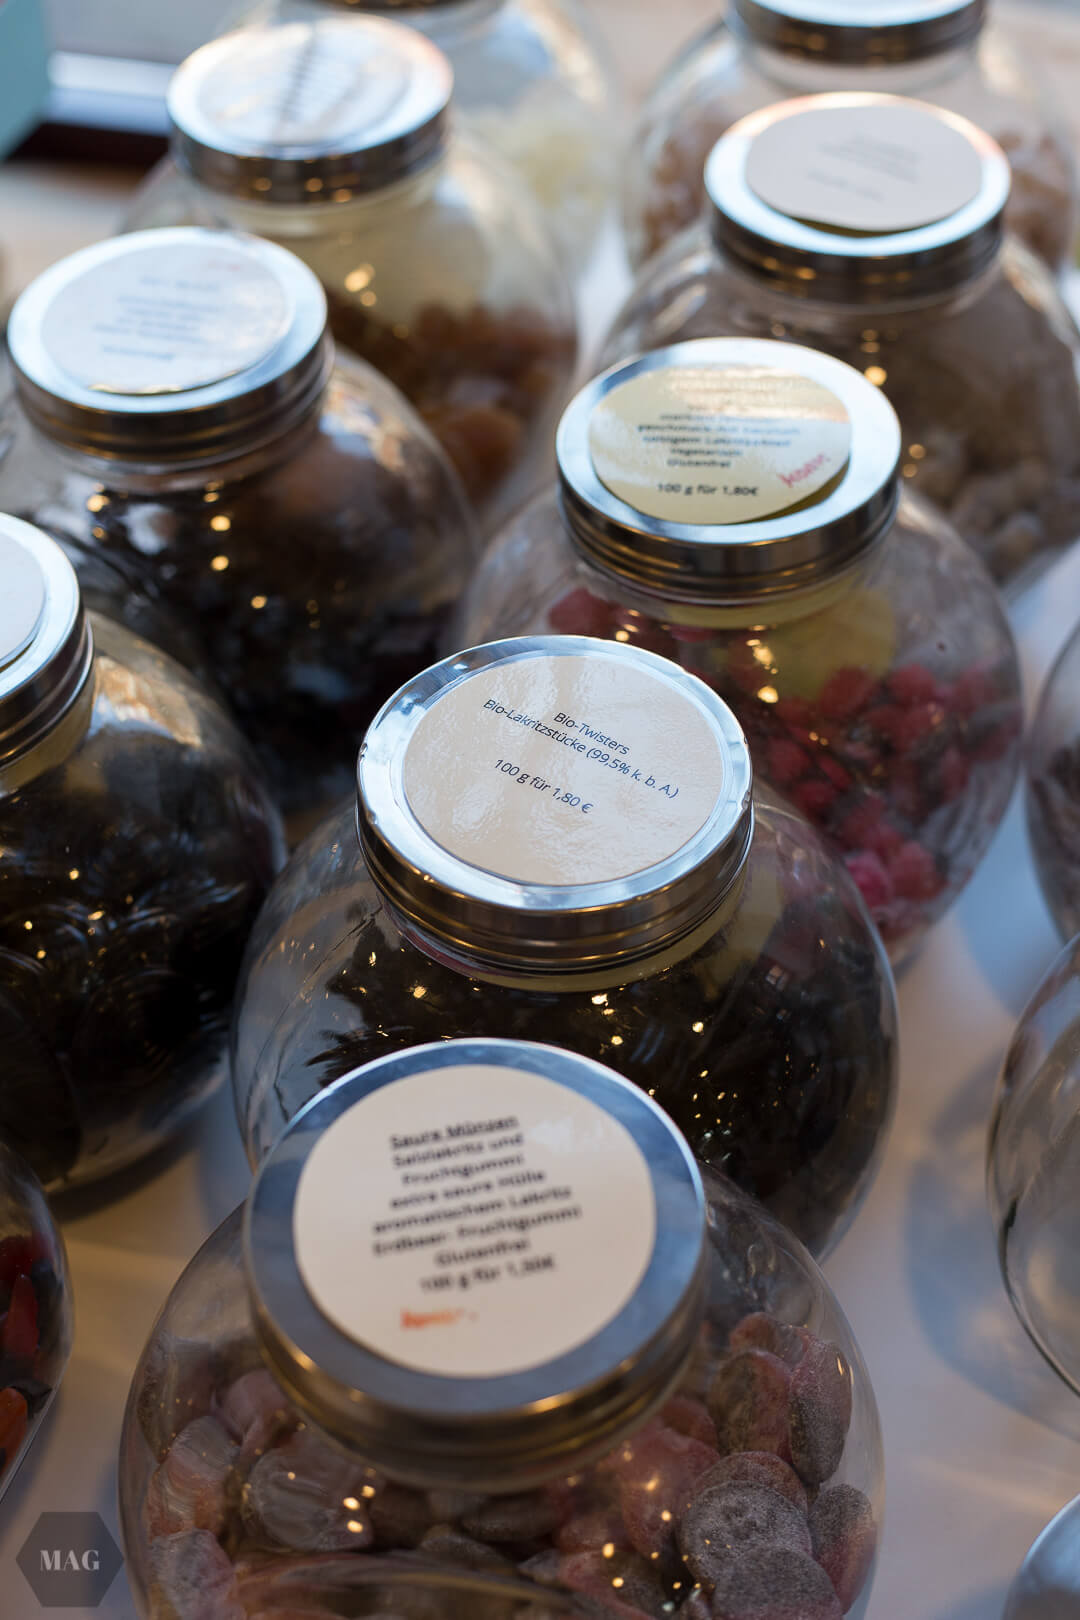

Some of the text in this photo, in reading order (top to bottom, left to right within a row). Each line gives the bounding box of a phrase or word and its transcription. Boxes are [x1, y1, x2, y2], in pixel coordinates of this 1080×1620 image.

[657, 483, 681, 493] 100
[684, 486, 693, 495] g
[697, 483, 717, 494] für
[483, 699, 680, 799] Bio-Lakritzstücke (99,5% k. b. A.)
[553, 712, 630, 755] Bio-Twisters
[494, 758, 594, 814] 100 g für 1,80 €
[490, 1133, 524, 1151] und
